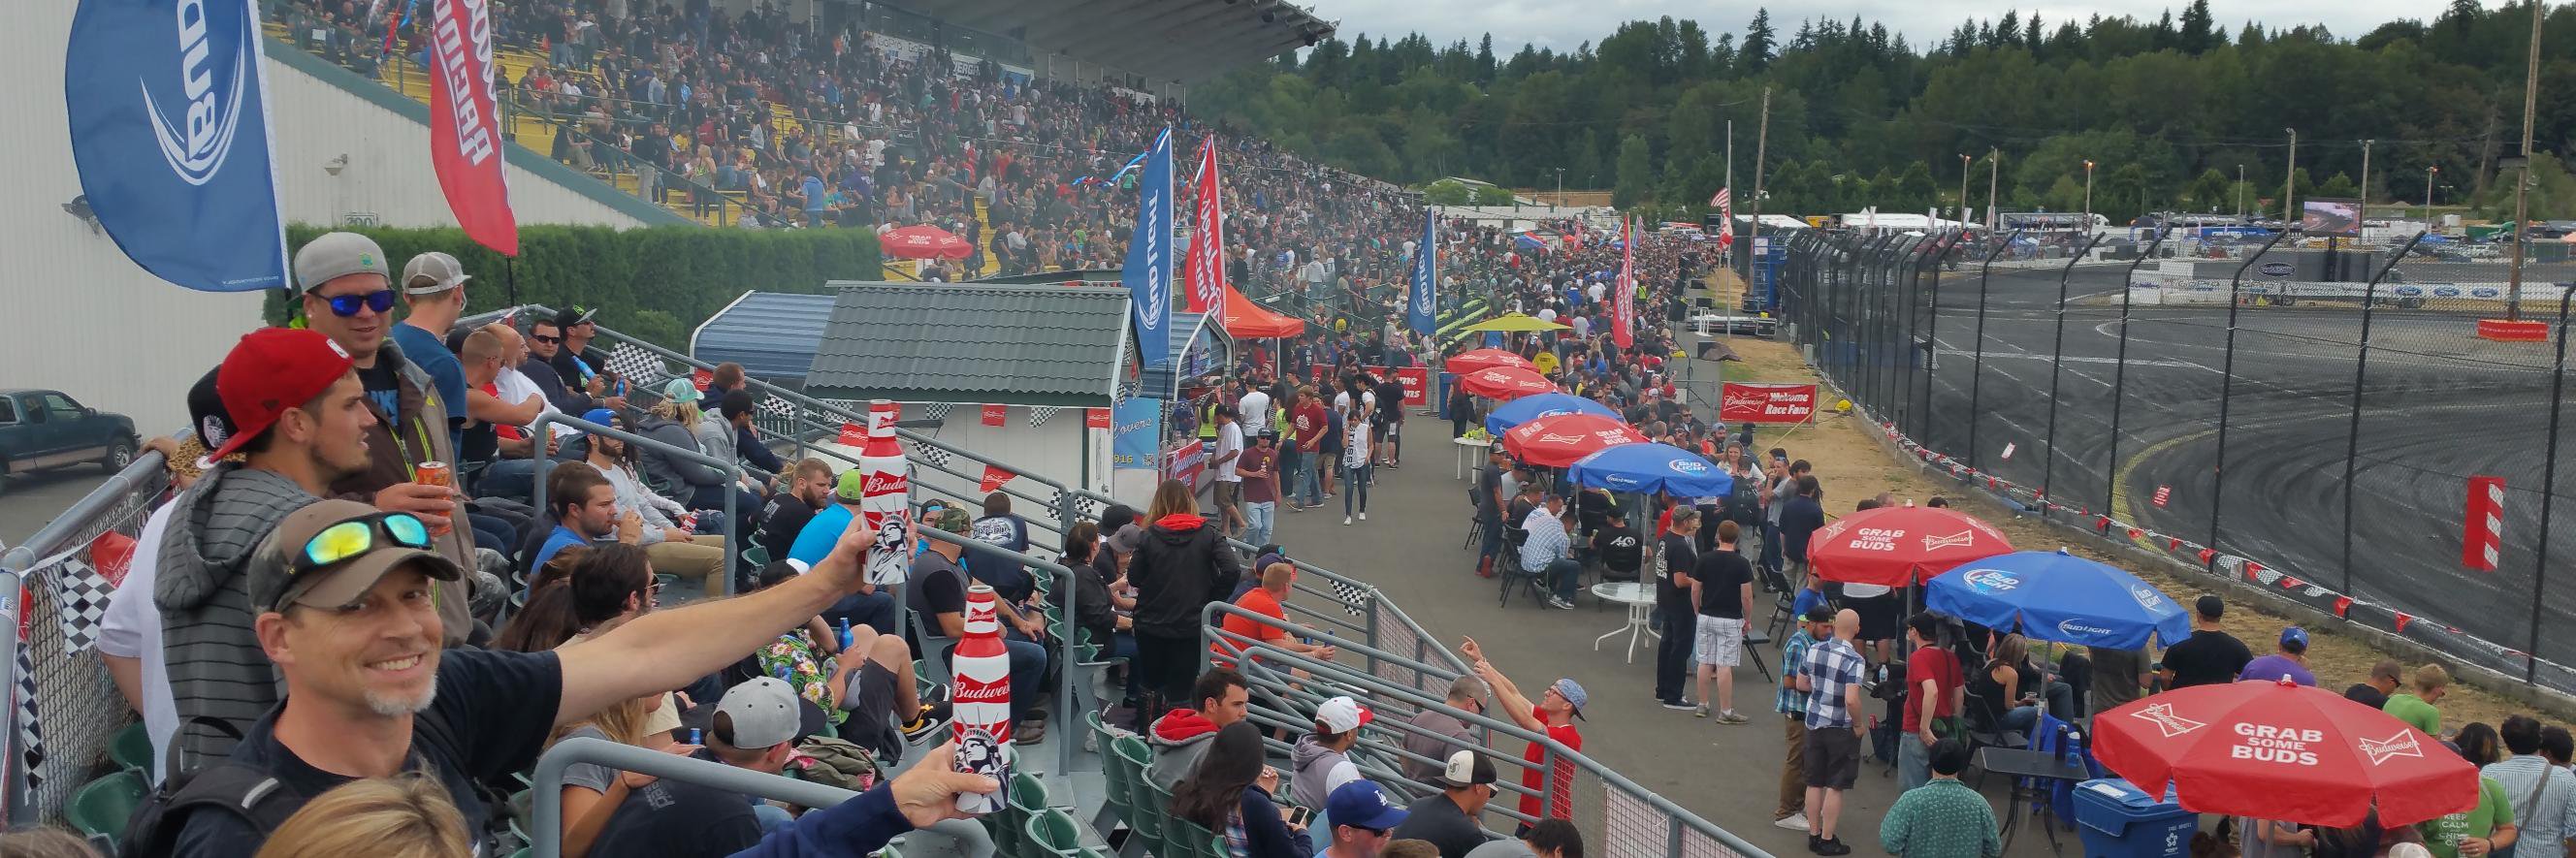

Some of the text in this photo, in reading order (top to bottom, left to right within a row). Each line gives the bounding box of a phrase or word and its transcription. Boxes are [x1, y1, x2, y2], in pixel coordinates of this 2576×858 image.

[1768, 392, 1809, 402] Welcome
[1765, 403, 1810, 415] Race Fans
[1858, 527, 1905, 538] GRAB
[1850, 540, 1896, 552] BUDS
[1971, 575, 2016, 590] LIGHT
[2234, 721, 2323, 743] GRAB
[2246, 737, 2305, 750] SOME
[2360, 740, 2419, 756] Budweiser
[2231, 745, 2318, 766] BUDS
